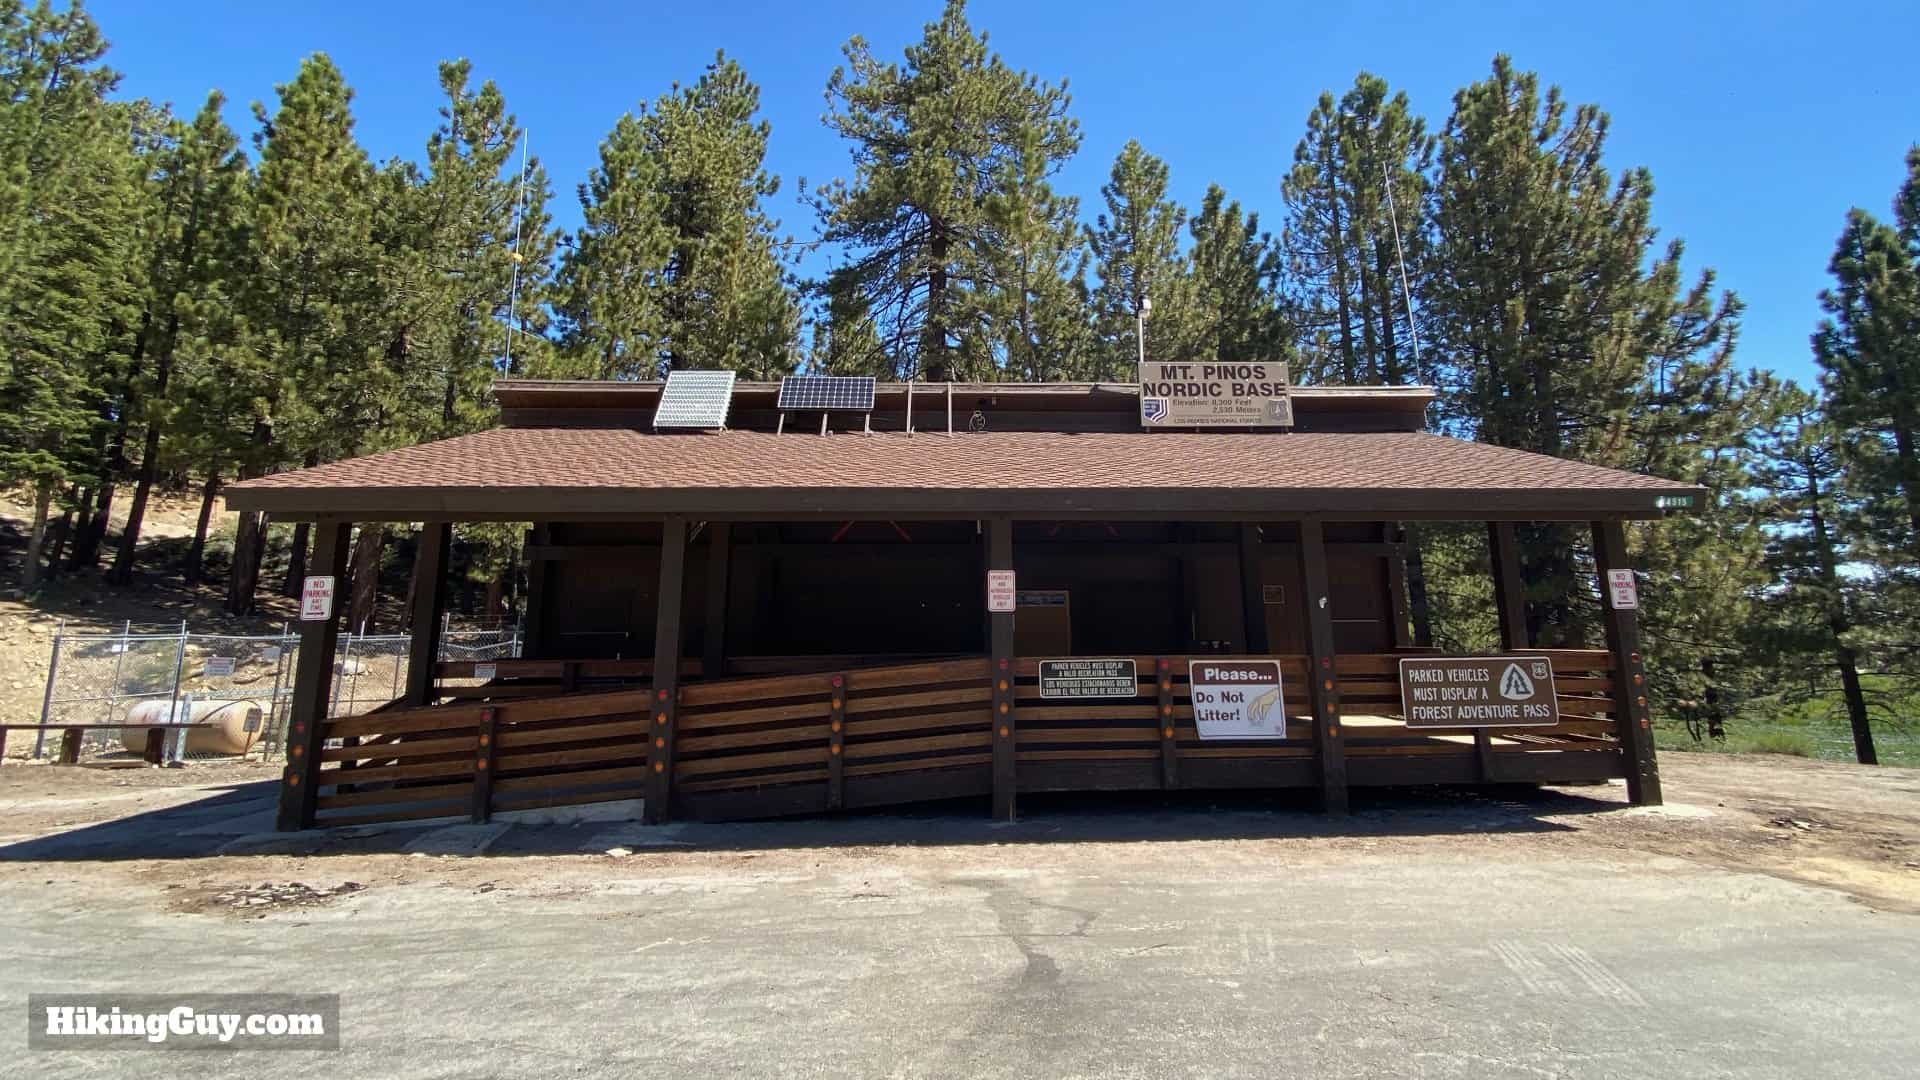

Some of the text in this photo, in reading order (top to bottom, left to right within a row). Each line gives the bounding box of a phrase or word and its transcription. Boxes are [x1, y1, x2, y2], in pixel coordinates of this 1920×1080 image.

[1160, 365, 1266, 380] MT. PINOS
[1143, 382, 1287, 397] NORDIC BASE
[313, 580, 325, 588] NO
[304, 590, 330, 598] PARKING
[1204, 668, 1272, 681] Please...
[1408, 668, 1490, 683] PARKED VEHICLES
[1196, 691, 1245, 703] Do Not
[1413, 687, 1489, 701] MUST DISPLAY A
[1197, 709, 1241, 721] Litter!
[1412, 704, 1551, 720] FOREST ADVENTURE PASS
